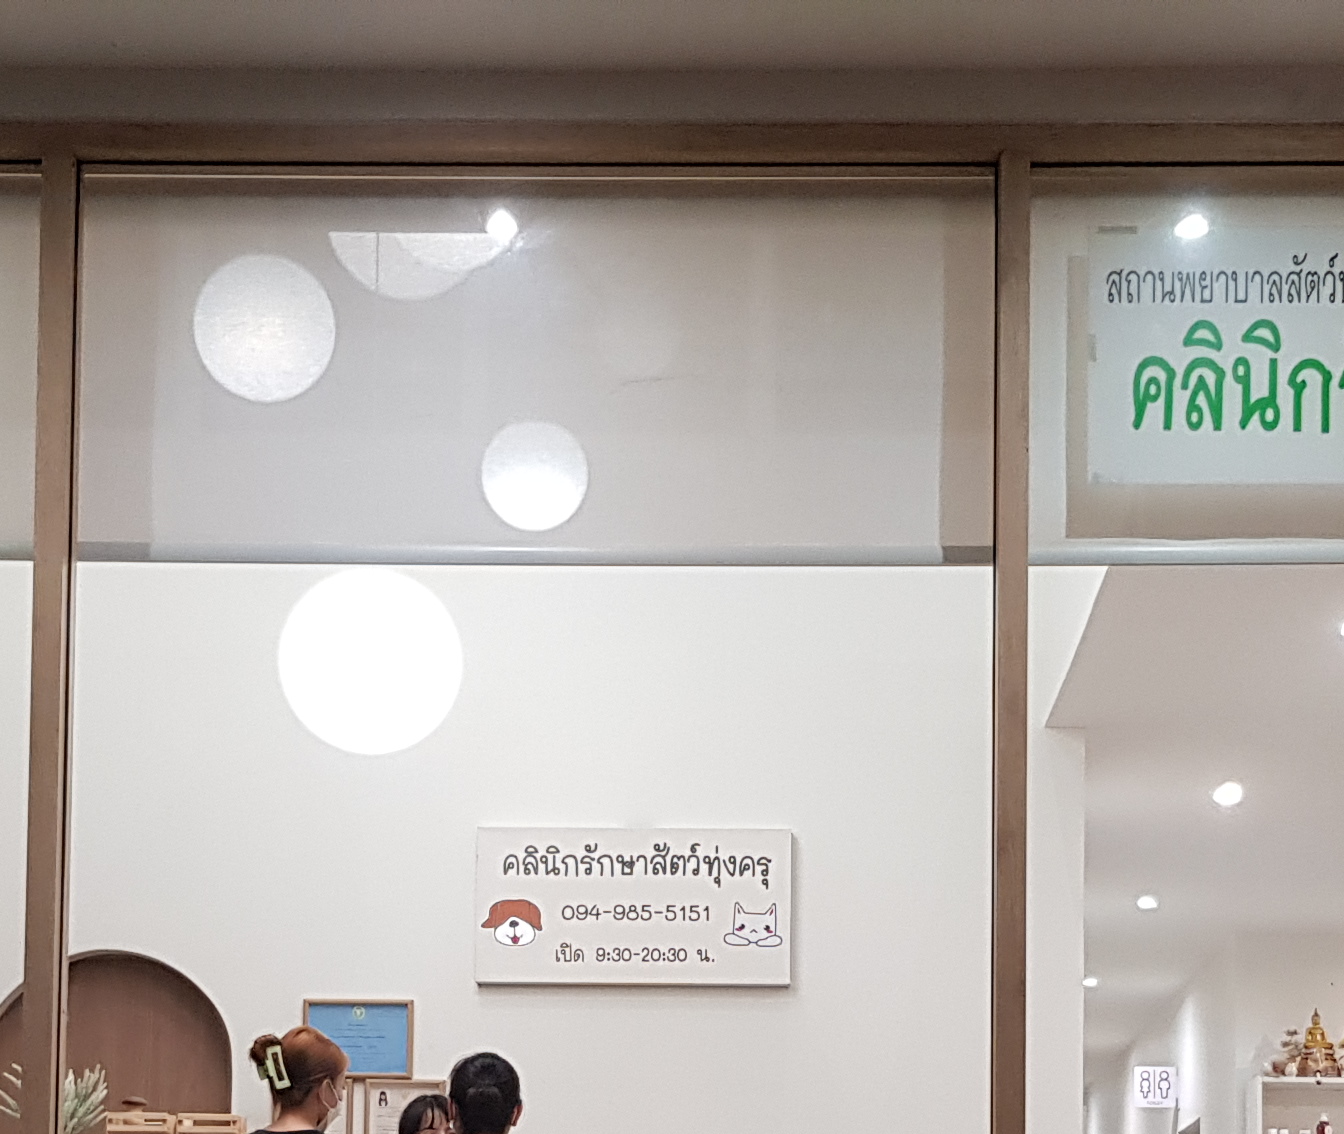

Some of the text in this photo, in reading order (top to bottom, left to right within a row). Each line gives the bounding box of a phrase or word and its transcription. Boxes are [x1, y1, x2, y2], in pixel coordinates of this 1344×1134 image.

[502, 842, 772, 890] คลินิกรักษาสัตว์ทุ่งครุ
[561, 904, 711, 922] 094-985-5151
[555, 942, 716, 963] เปิด 9:30-20:30 น.
